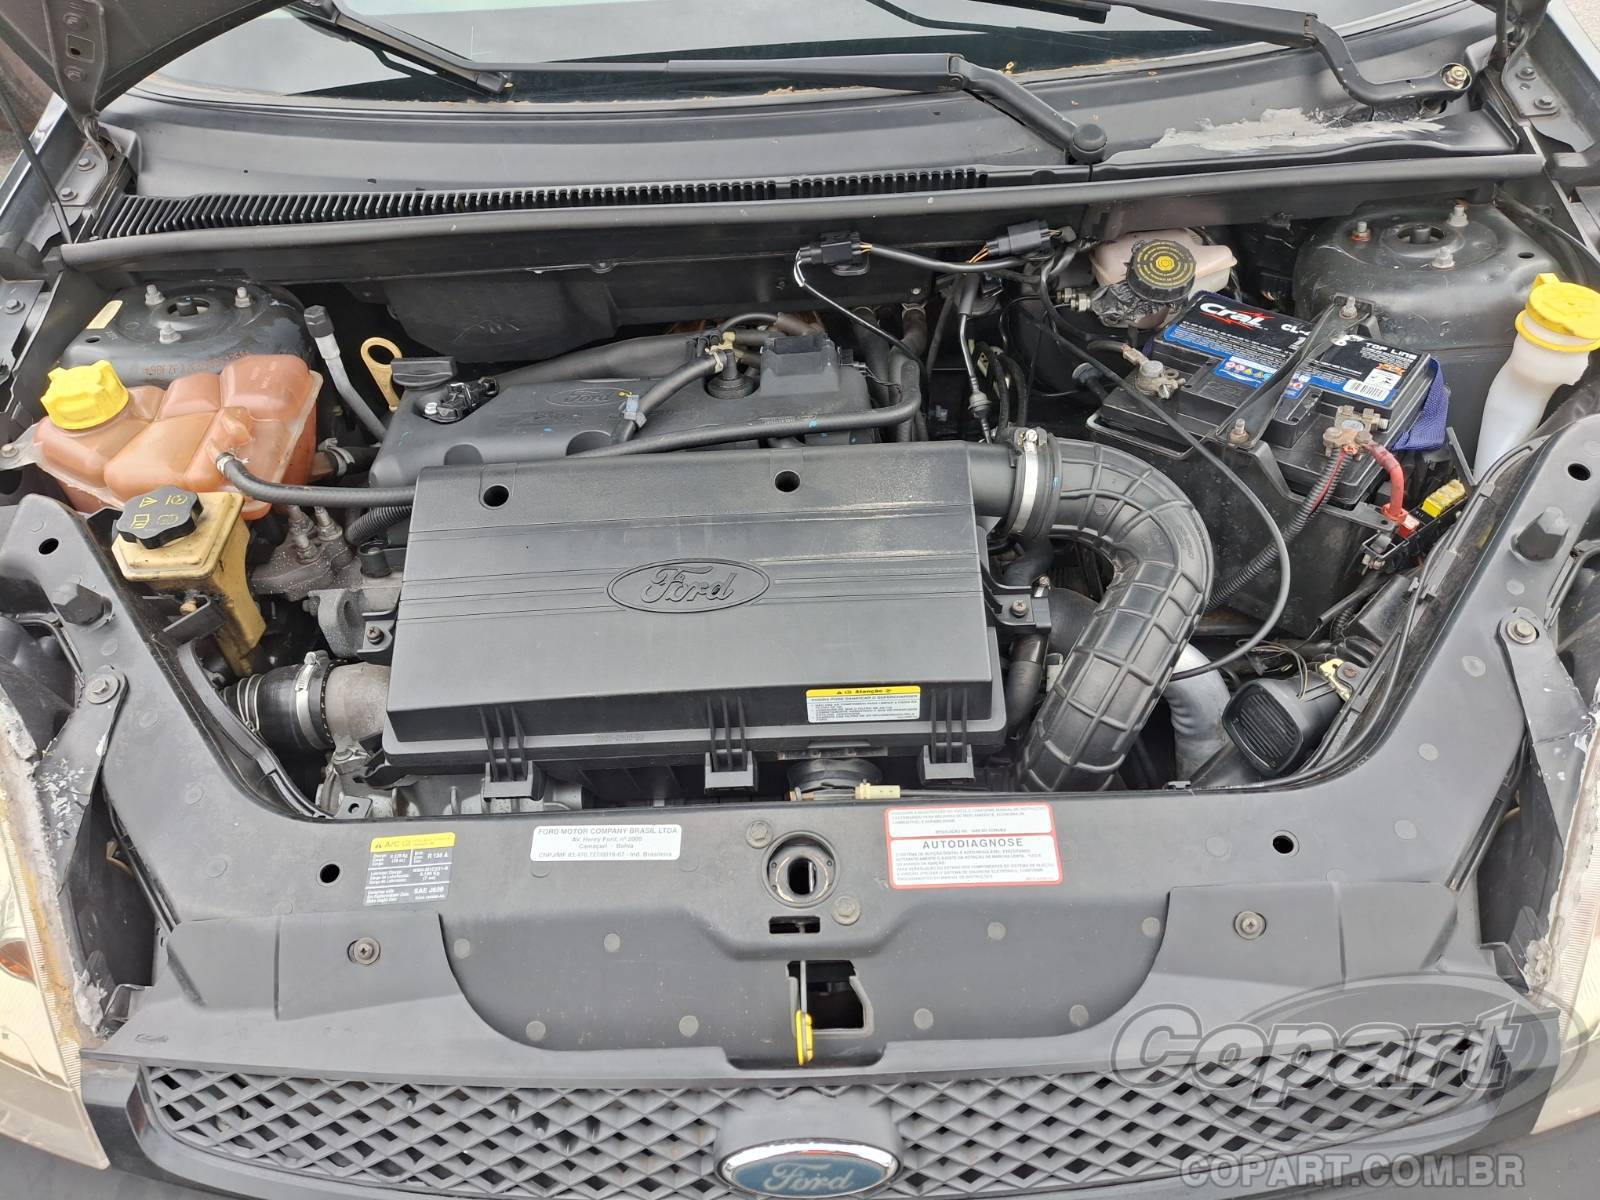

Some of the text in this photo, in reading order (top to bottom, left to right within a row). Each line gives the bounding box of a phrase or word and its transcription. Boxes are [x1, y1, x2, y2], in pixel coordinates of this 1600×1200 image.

[1366, 342, 1388, 351] TOP
[640, 565, 738, 604] Ford
[590, 827, 627, 835] COMPANY
[922, 837, 1024, 849] AUTODIAGNOSE
[763, 1162, 855, 1191] Ford
